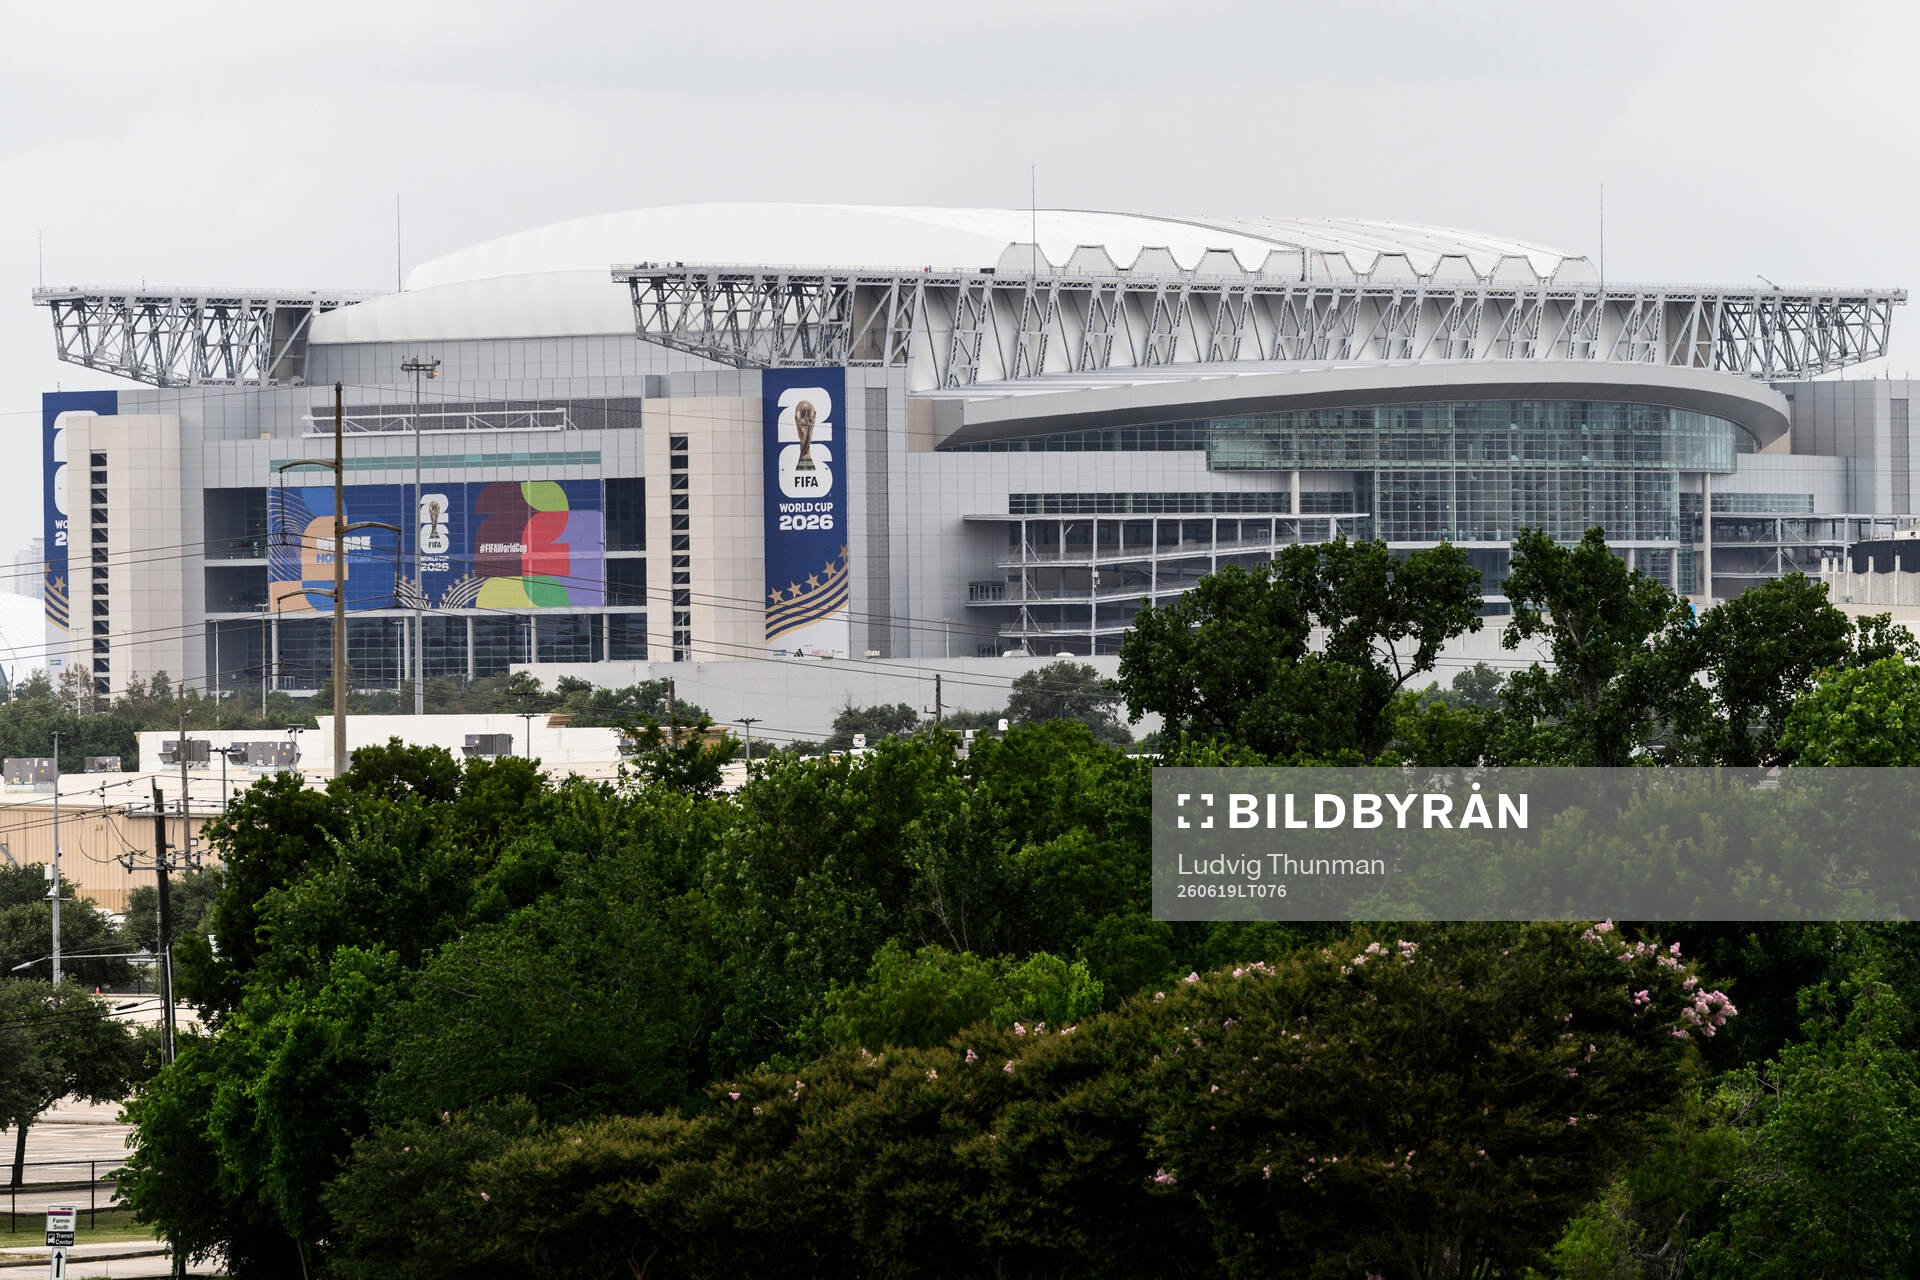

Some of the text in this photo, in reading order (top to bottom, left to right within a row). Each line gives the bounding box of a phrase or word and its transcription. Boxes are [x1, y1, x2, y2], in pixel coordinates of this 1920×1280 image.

[794, 476, 819, 487] FIFA
[779, 502, 833, 513] WORLD CUP
[779, 514, 833, 530] 2026
[480, 543, 527, 554] #FIFAWorldCup
[420, 562, 449, 571] 2026
